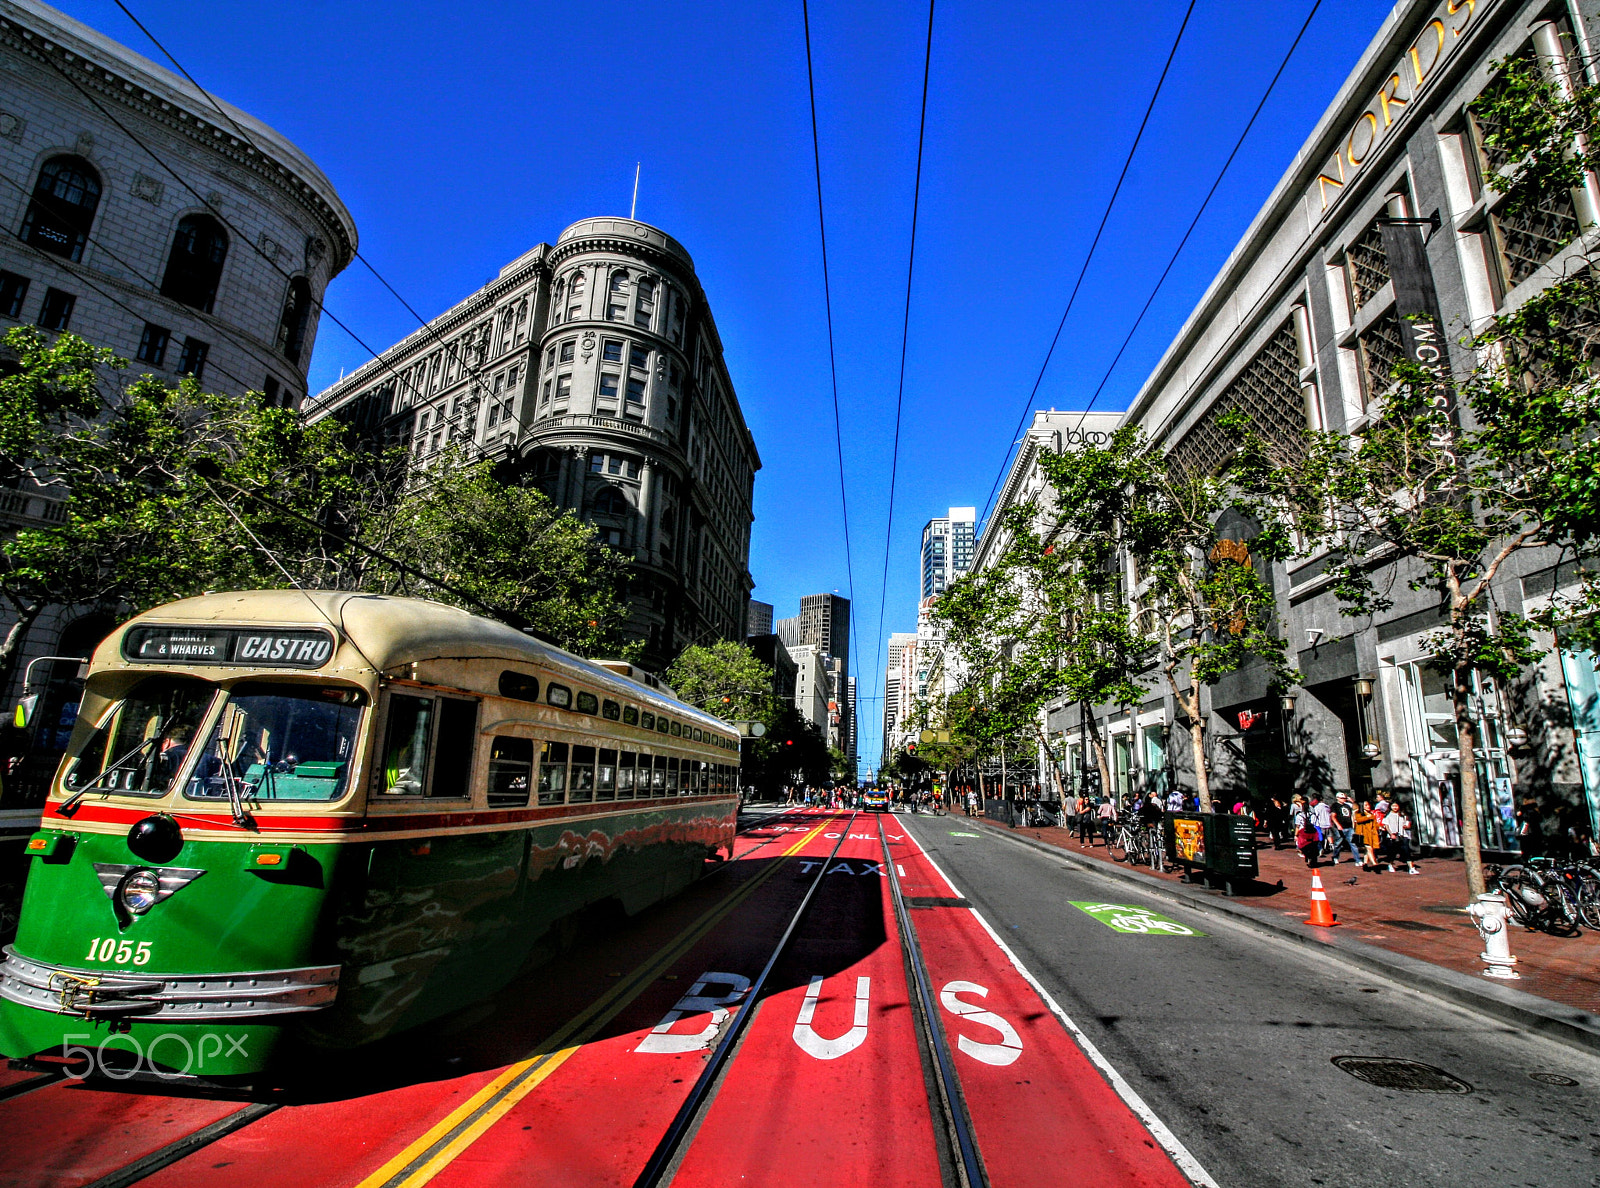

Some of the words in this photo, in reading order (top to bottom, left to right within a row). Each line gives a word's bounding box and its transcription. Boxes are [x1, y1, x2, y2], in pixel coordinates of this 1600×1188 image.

[159, 645, 167, 654] &
[171, 645, 215, 656] WHARVES
[242, 637, 330, 661] CASTRO
[824, 832, 904, 841] ONLY
[800, 860, 906, 877] TAXI
[85, 937, 153, 966] 1055
[634, 972, 1023, 1066] BUS
